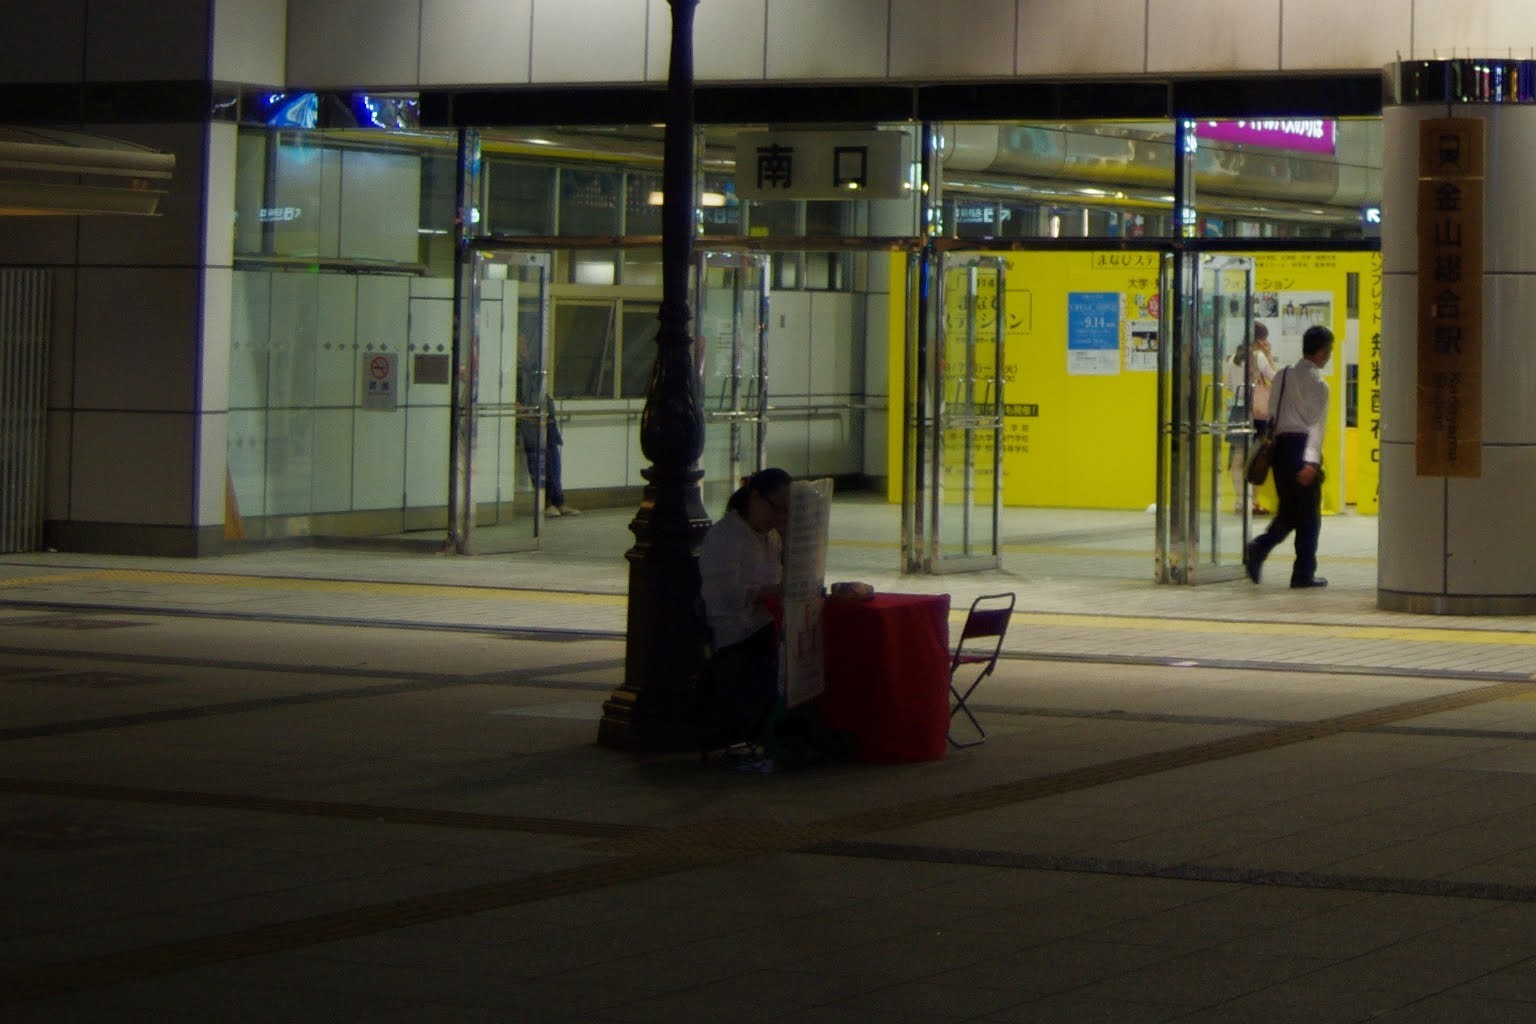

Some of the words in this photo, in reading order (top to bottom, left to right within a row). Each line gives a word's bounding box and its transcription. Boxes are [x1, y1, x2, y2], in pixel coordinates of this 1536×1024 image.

[757, 143, 868, 189] 南口
[1433, 182, 1462, 355] 金山総合駅
